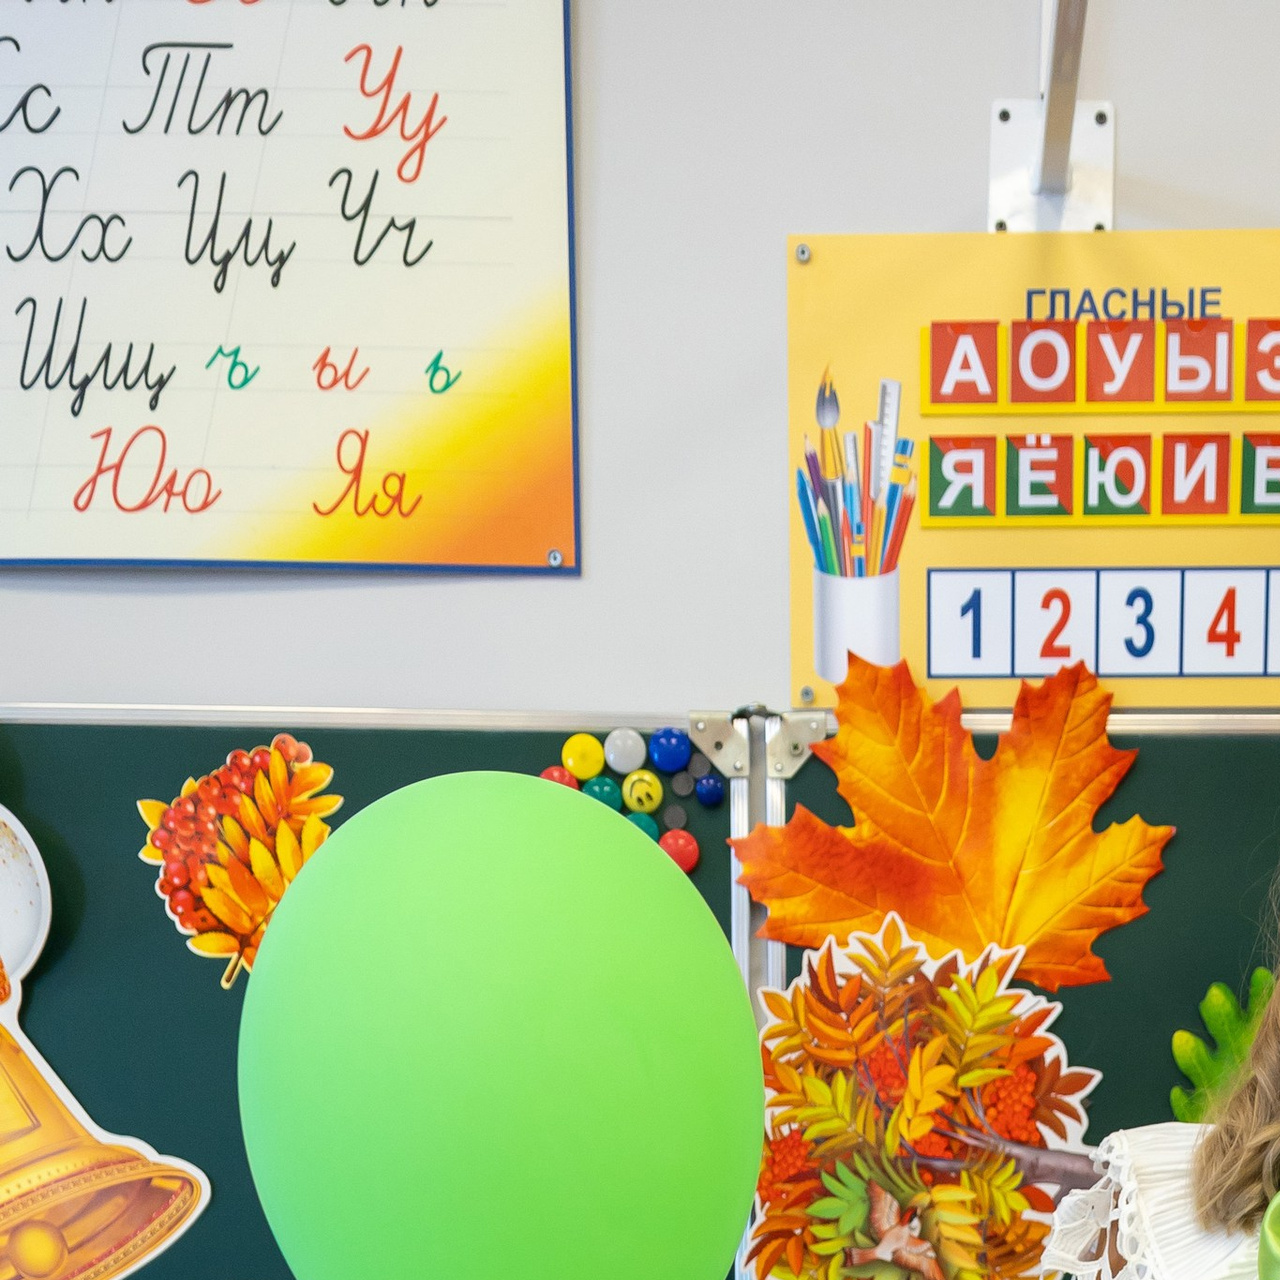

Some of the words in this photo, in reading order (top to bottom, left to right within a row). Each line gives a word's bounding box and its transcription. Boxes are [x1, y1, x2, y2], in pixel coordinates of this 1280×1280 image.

[343, 43, 448, 183] Уу
[6, 166, 133, 262] Хх
[177, 170, 296, 293] Цц
[328, 168, 433, 266] Чч
[15, 296, 176, 417] Щщ
[206, 345, 260, 389] ъ
[313, 346, 370, 391] ы
[1025, 287, 1222, 320] ГЛАСНЫЕ
[73, 425, 222, 513] Юю
[313, 429, 423, 518] Яя
[960, 588, 982, 659] 1
[1039, 588, 1071, 659] 2
[1124, 587, 1155, 657] 3
[1207, 586, 1240, 657] 4
